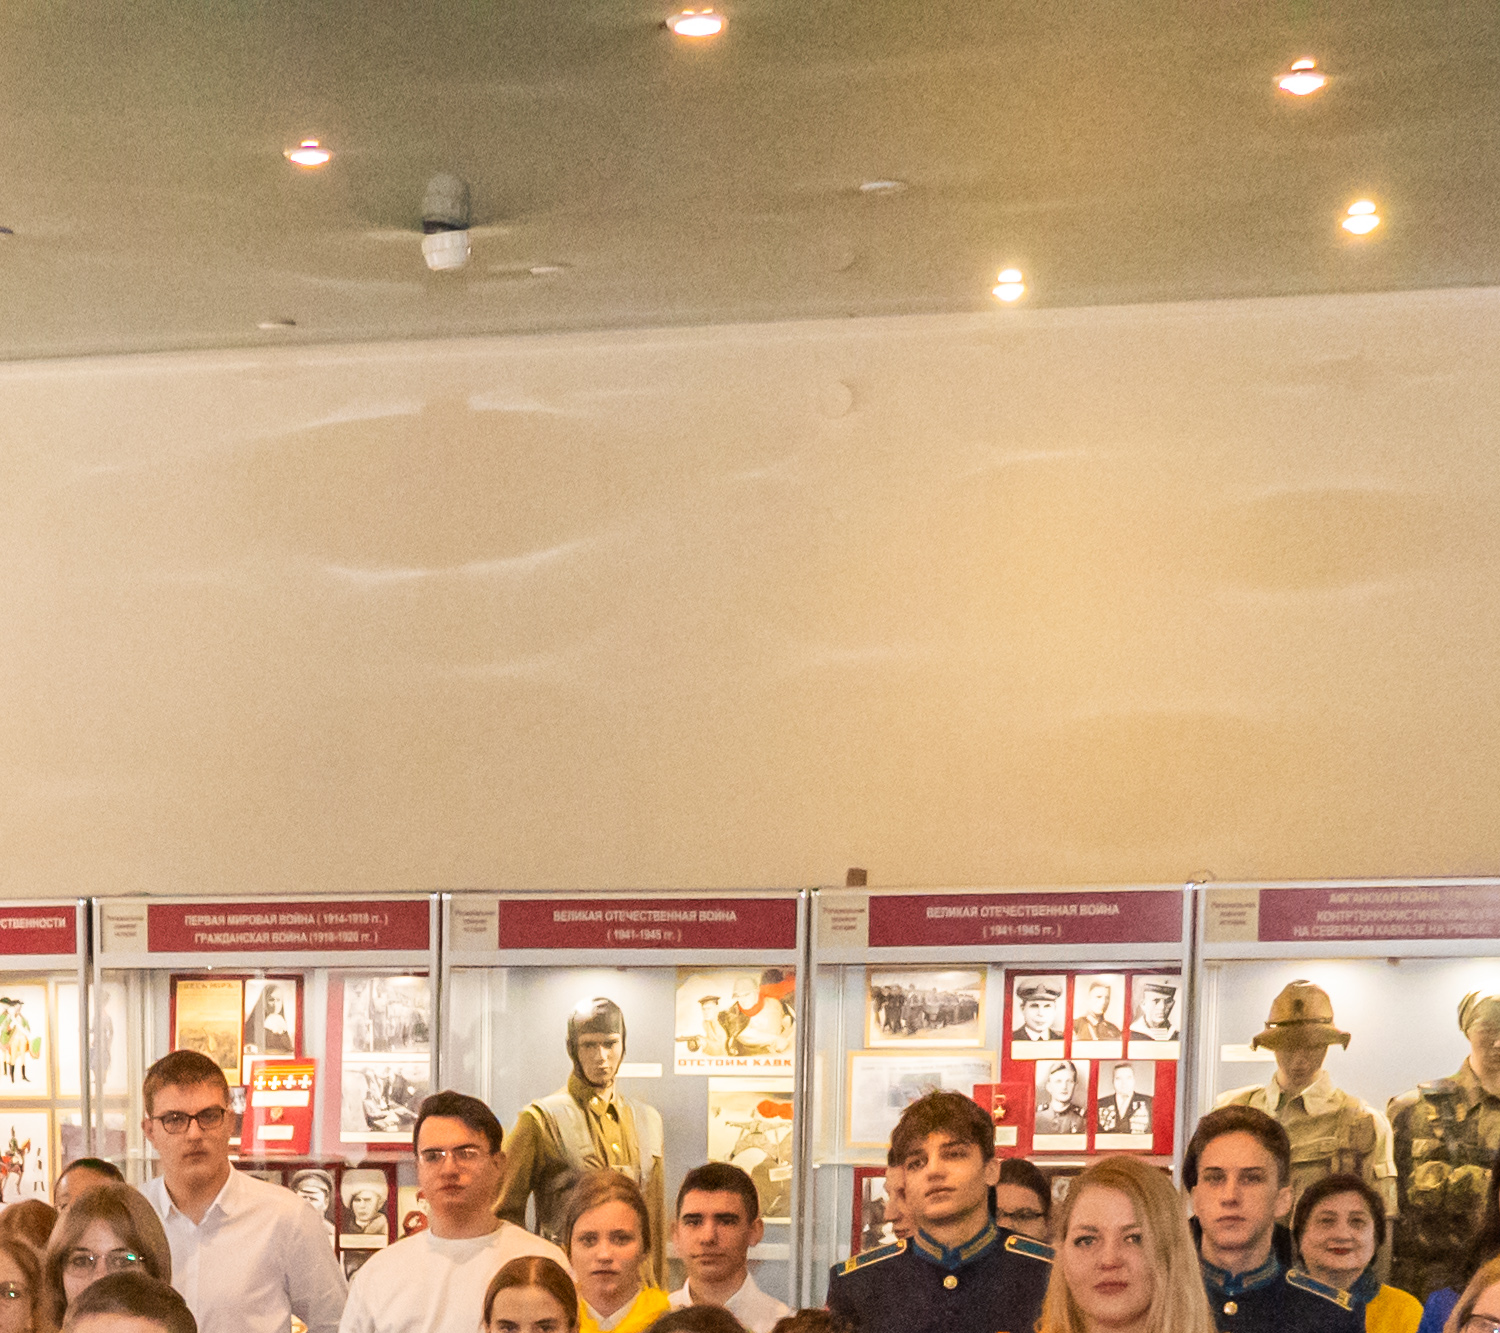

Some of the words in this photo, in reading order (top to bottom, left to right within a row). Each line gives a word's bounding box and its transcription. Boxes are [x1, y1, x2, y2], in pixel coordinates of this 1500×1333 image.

[553, 910, 603, 921] ВЕЛИКАЯ
[605, 910, 697, 921] ОТЕЧЕСТВЕННАЯ
[698, 909, 737, 921] ВОЙНА
[926, 906, 979, 918] ВЕЛИКАЯ
[980, 905, 1078, 917] ОТЕЧЕСТВЕННАЯ
[1079, 903, 1120, 916] ВОЙНА
[185, 914, 225, 926] ПЕРВАЯ
[227, 913, 277, 925] МИРОВАЯ
[278, 912, 315, 925] ВОЙНА
[614, 929, 662, 940] 1941-1945
[990, 925, 1041, 936] 1941-1945
[1293, 925, 1309, 937] НА
[194, 932, 270, 944] ГРАЖДАНСКАЯ
[272, 931, 308, 943] ВОЙНА
